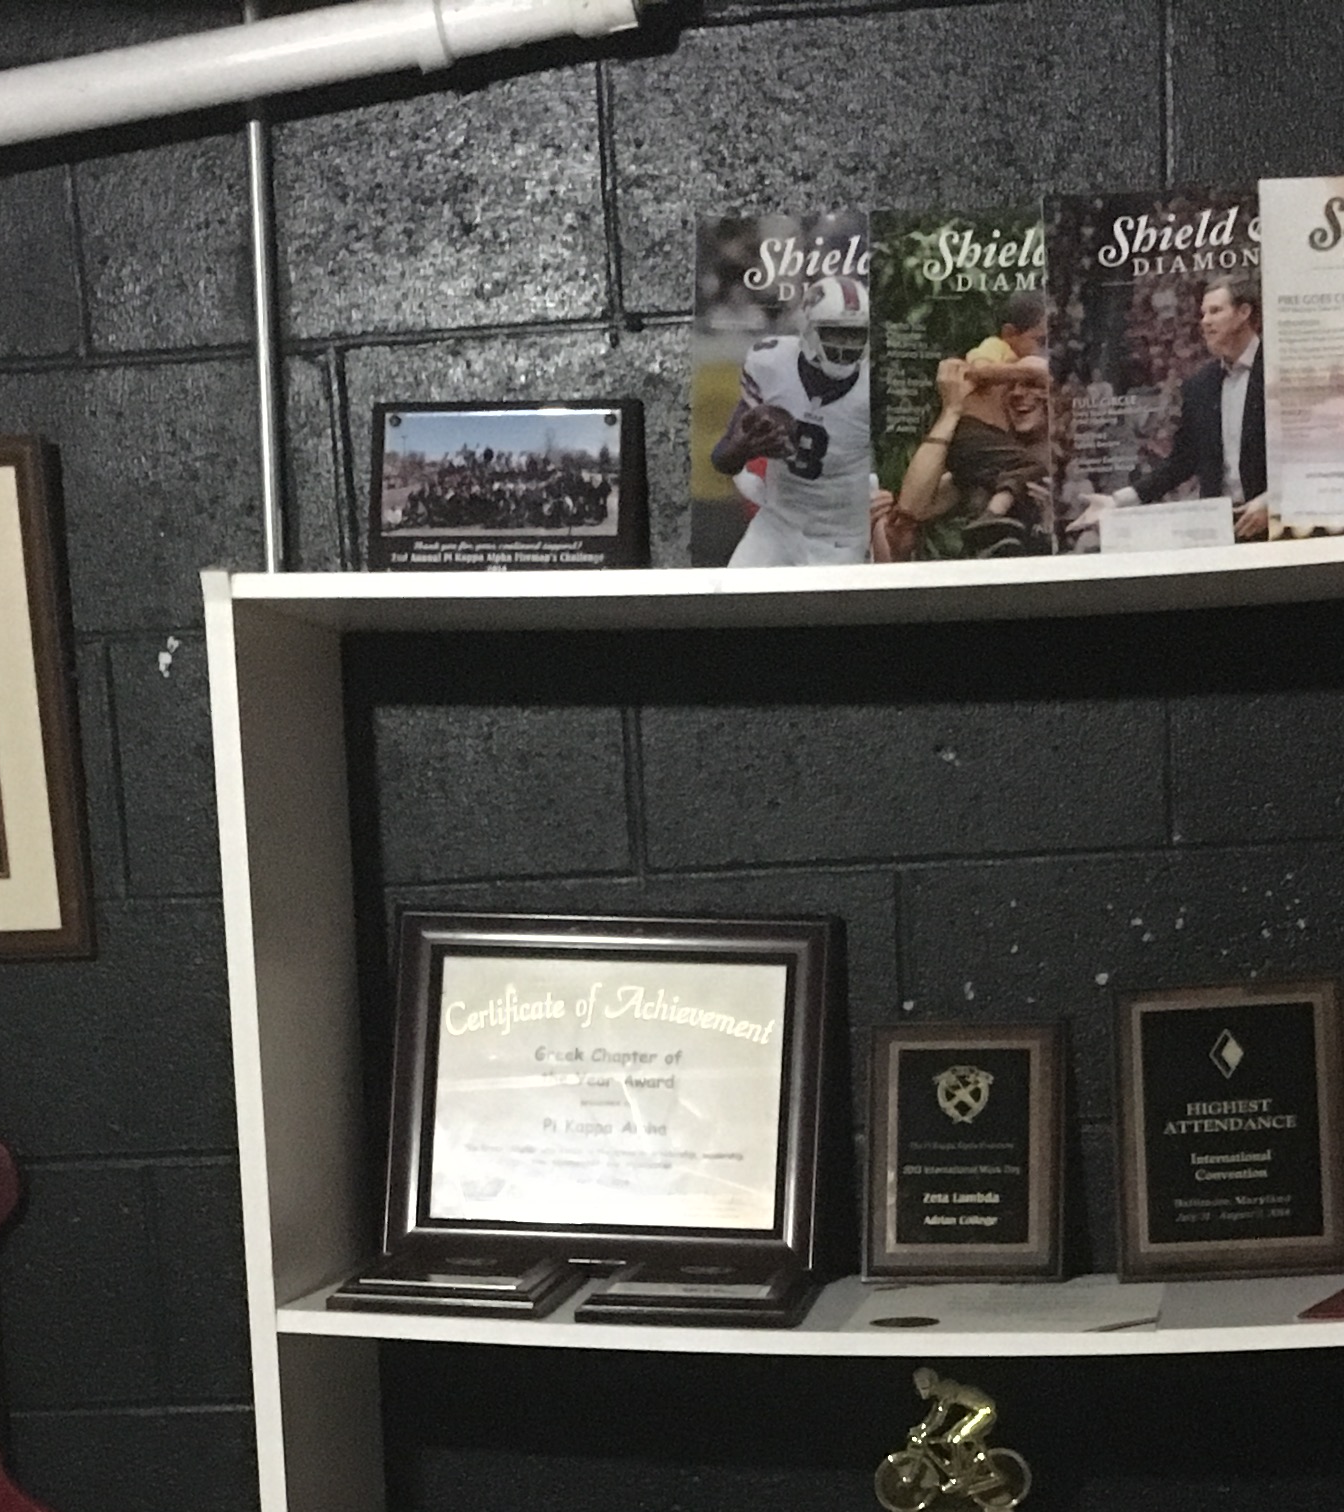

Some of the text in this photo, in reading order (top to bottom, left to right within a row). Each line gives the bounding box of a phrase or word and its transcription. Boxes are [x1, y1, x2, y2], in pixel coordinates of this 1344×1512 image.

[1097, 205, 1240, 268] Shield
[956, 272, 1047, 292] DIAM
[444, 982, 778, 1045] Certificate of Achievement
[1186, 1099, 1273, 1116] HIGHEST
[1163, 1114, 1297, 1135] ATTENDANCE
[1190, 1149, 1272, 1165] International
[1194, 1167, 1268, 1182] Convention
